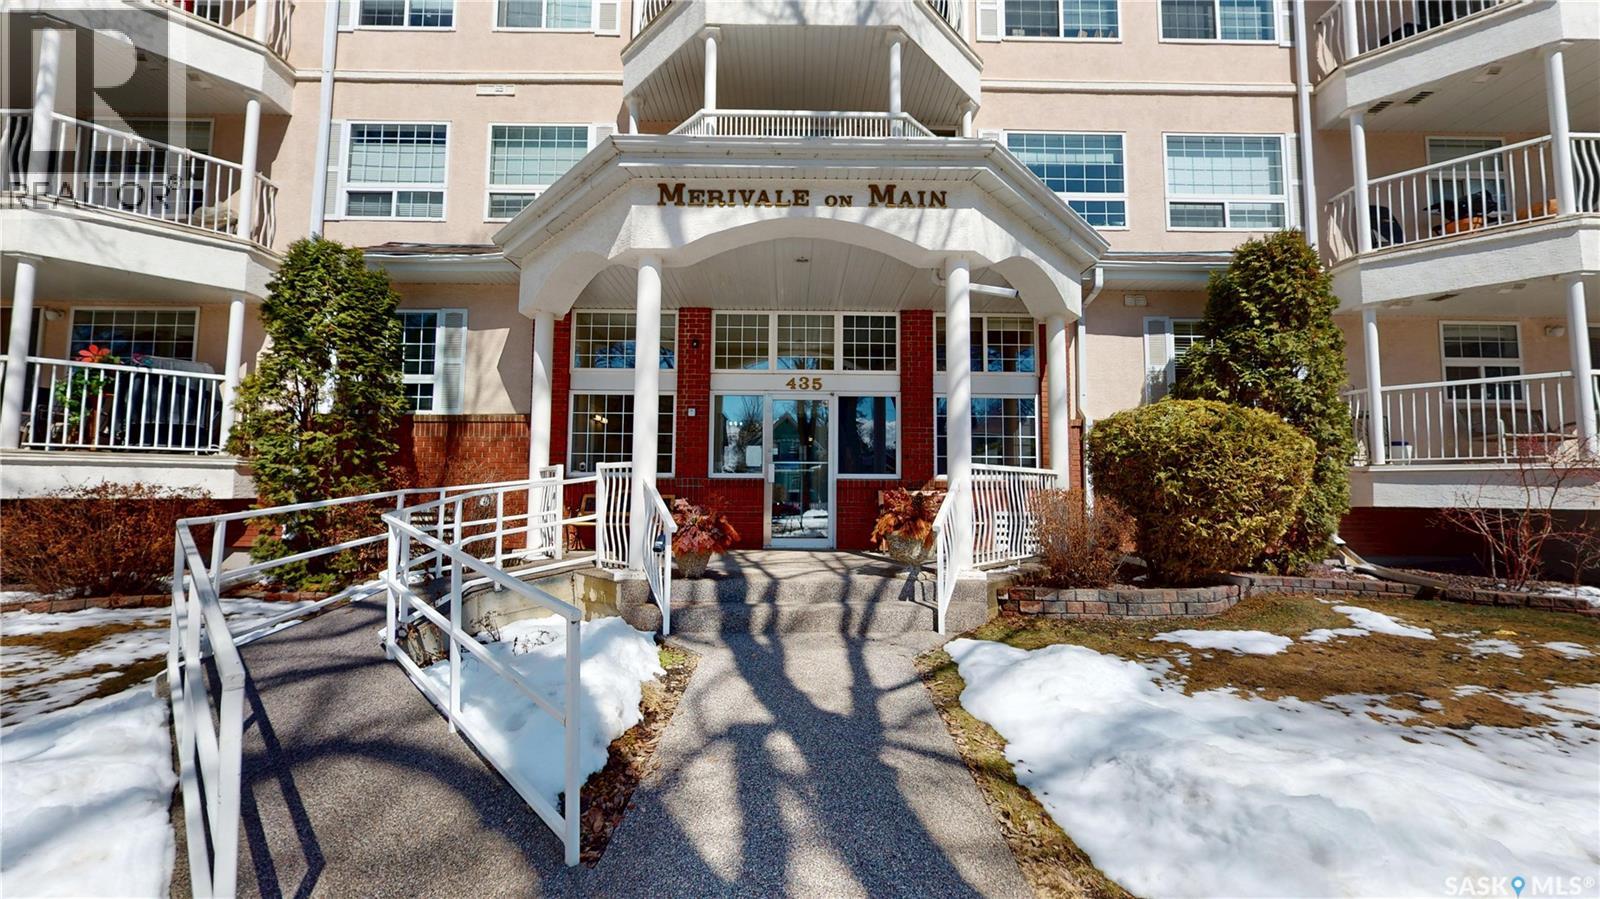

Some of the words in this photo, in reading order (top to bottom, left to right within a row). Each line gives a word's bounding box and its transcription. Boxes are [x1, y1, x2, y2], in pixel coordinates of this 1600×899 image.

[657, 183, 810, 208] MERIVALE
[868, 184, 948, 209] MAIN
[785, 377, 823, 391] 435
